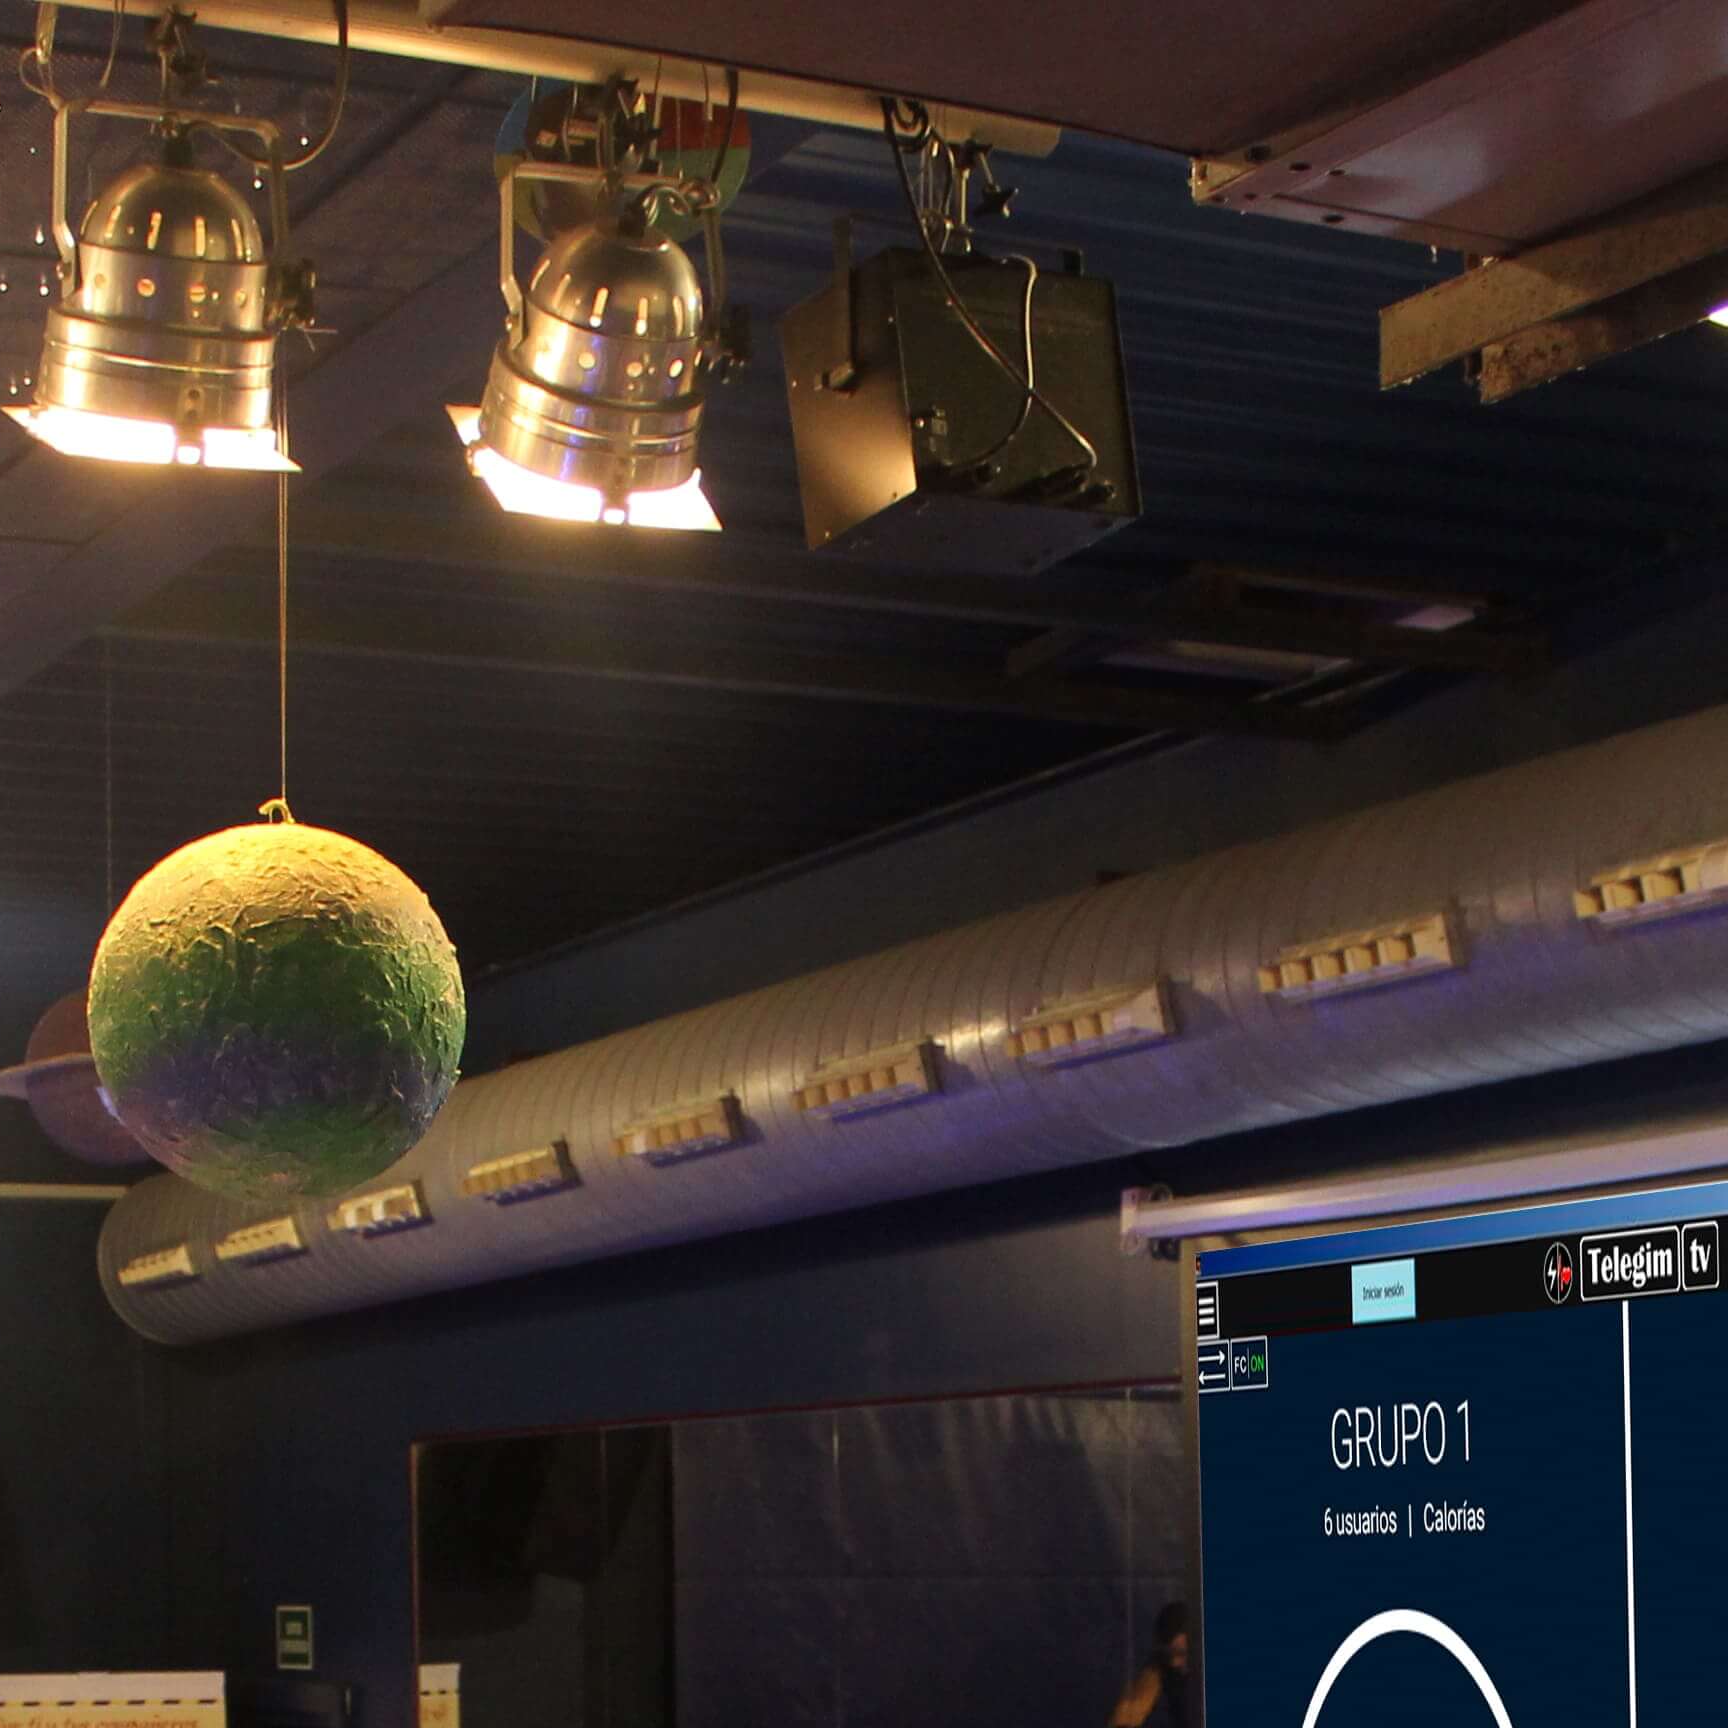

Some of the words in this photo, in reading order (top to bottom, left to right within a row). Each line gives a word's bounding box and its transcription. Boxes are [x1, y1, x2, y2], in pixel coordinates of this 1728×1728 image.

[1587, 1241, 1673, 1289] Telegim
[1689, 1237, 1711, 1274] tv
[1362, 1286, 1383, 1301] Iniciar
[1234, 1355, 1247, 1375] FC
[1250, 1353, 1264, 1372] ON
[1331, 1401, 1446, 1470] GRUPO
[1456, 1399, 1471, 1462] 1
[1324, 1507, 1333, 1536] 6
[1336, 1505, 1398, 1536] usuarios
[1423, 1500, 1486, 1533] Calorías
